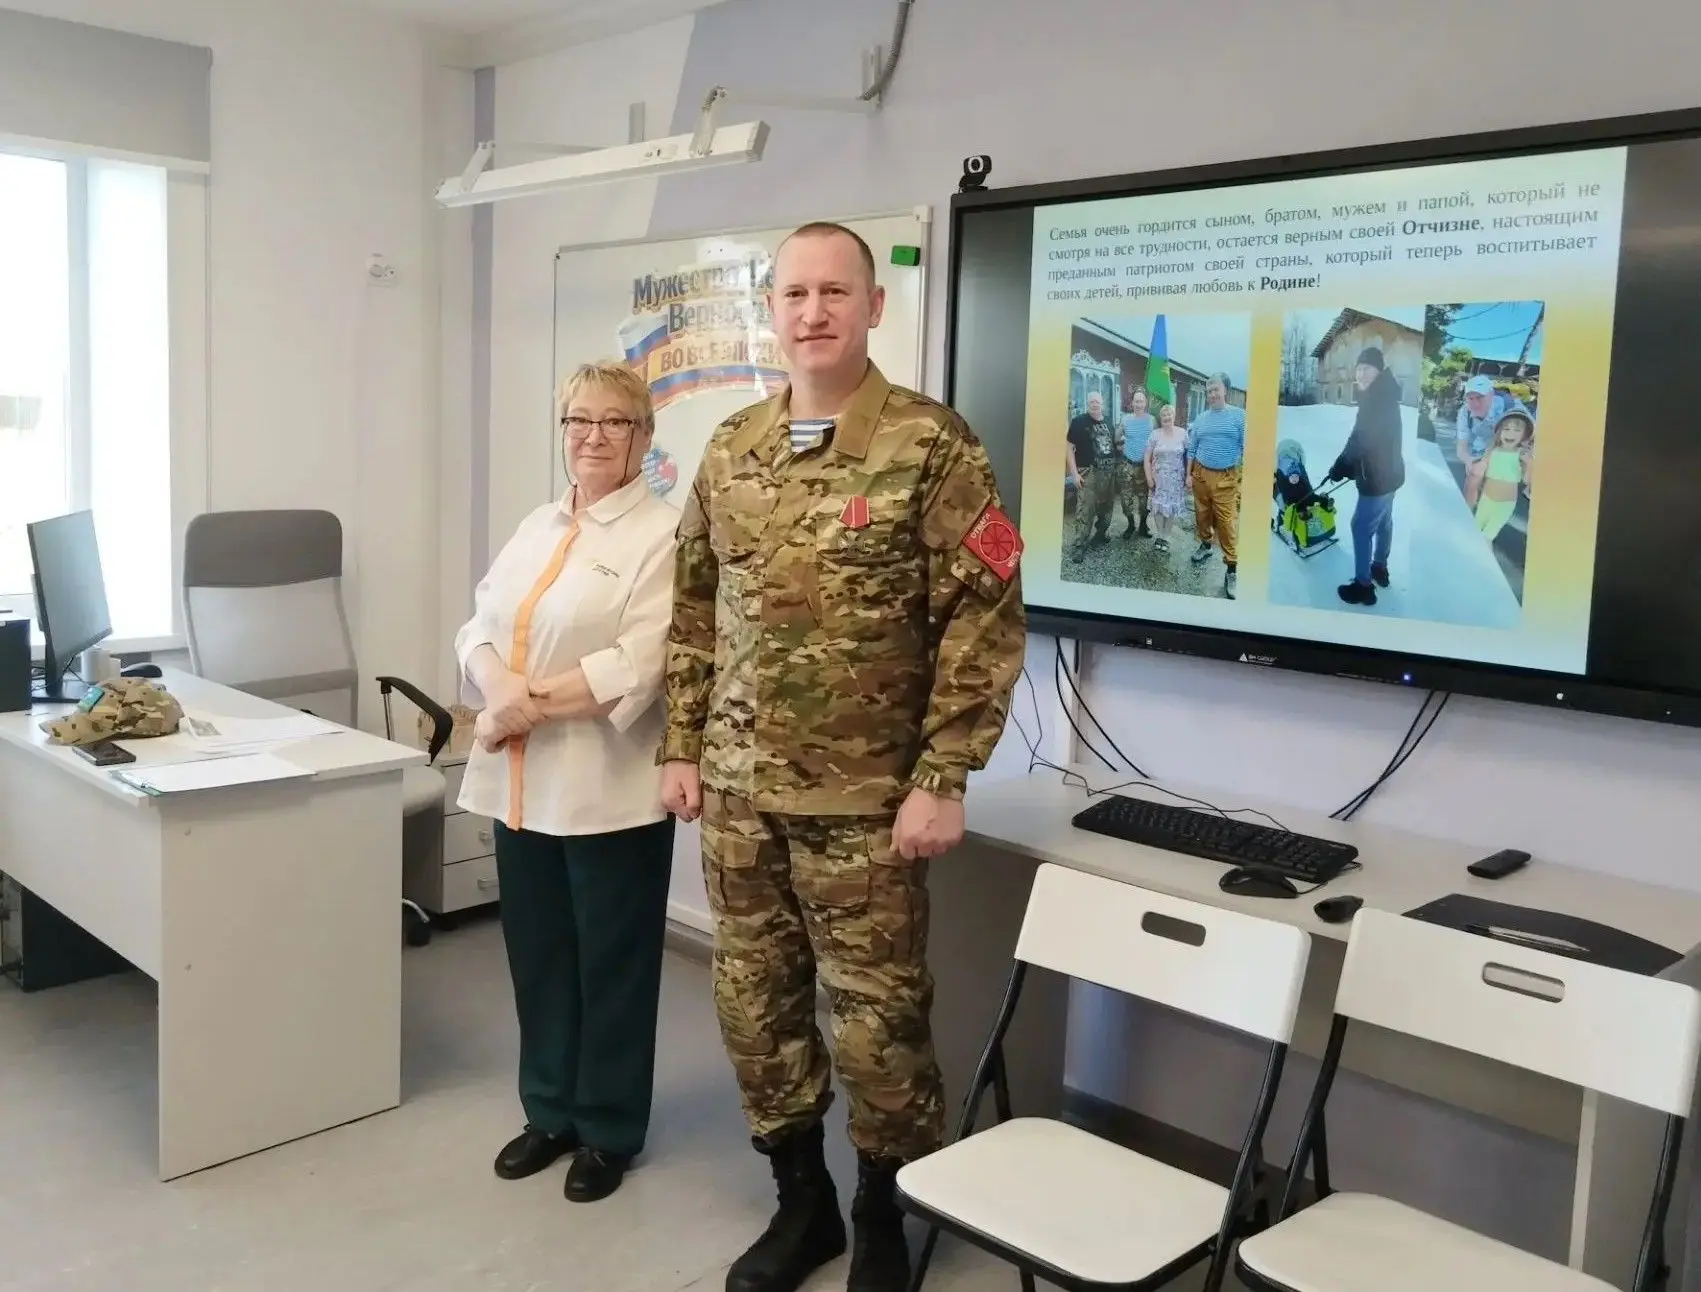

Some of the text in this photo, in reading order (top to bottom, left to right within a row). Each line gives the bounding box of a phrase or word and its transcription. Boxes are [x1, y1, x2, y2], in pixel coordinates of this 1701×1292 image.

[1048, 247, 1091, 262] смотря
[1095, 246, 1110, 258] на
[1113, 244, 1135, 257] все
[1139, 238, 1211, 258] трудности,
[1216, 232, 1279, 250] остается
[1284, 227, 1343, 245] верным
[1349, 222, 1396, 240] своей
[1492, 208, 1599, 230] настоящим
[1049, 182, 1601, 241] Семья очень гордится сыном, братом, мужем и папой, который не
[1047, 266, 1117, 283] преданным
[1125, 260, 1195, 279] патриотом
[1204, 256, 1245, 272] своей
[1325, 246, 1393, 266] который
[1407, 243, 1463, 261] теперь
[1477, 235, 1598, 256] воспитывает
[632, 267, 748, 314] Мужеств
[1046, 274, 1321, 301] своих детей, прививая любовь к Родине!
[660, 345, 684, 373] ВО
